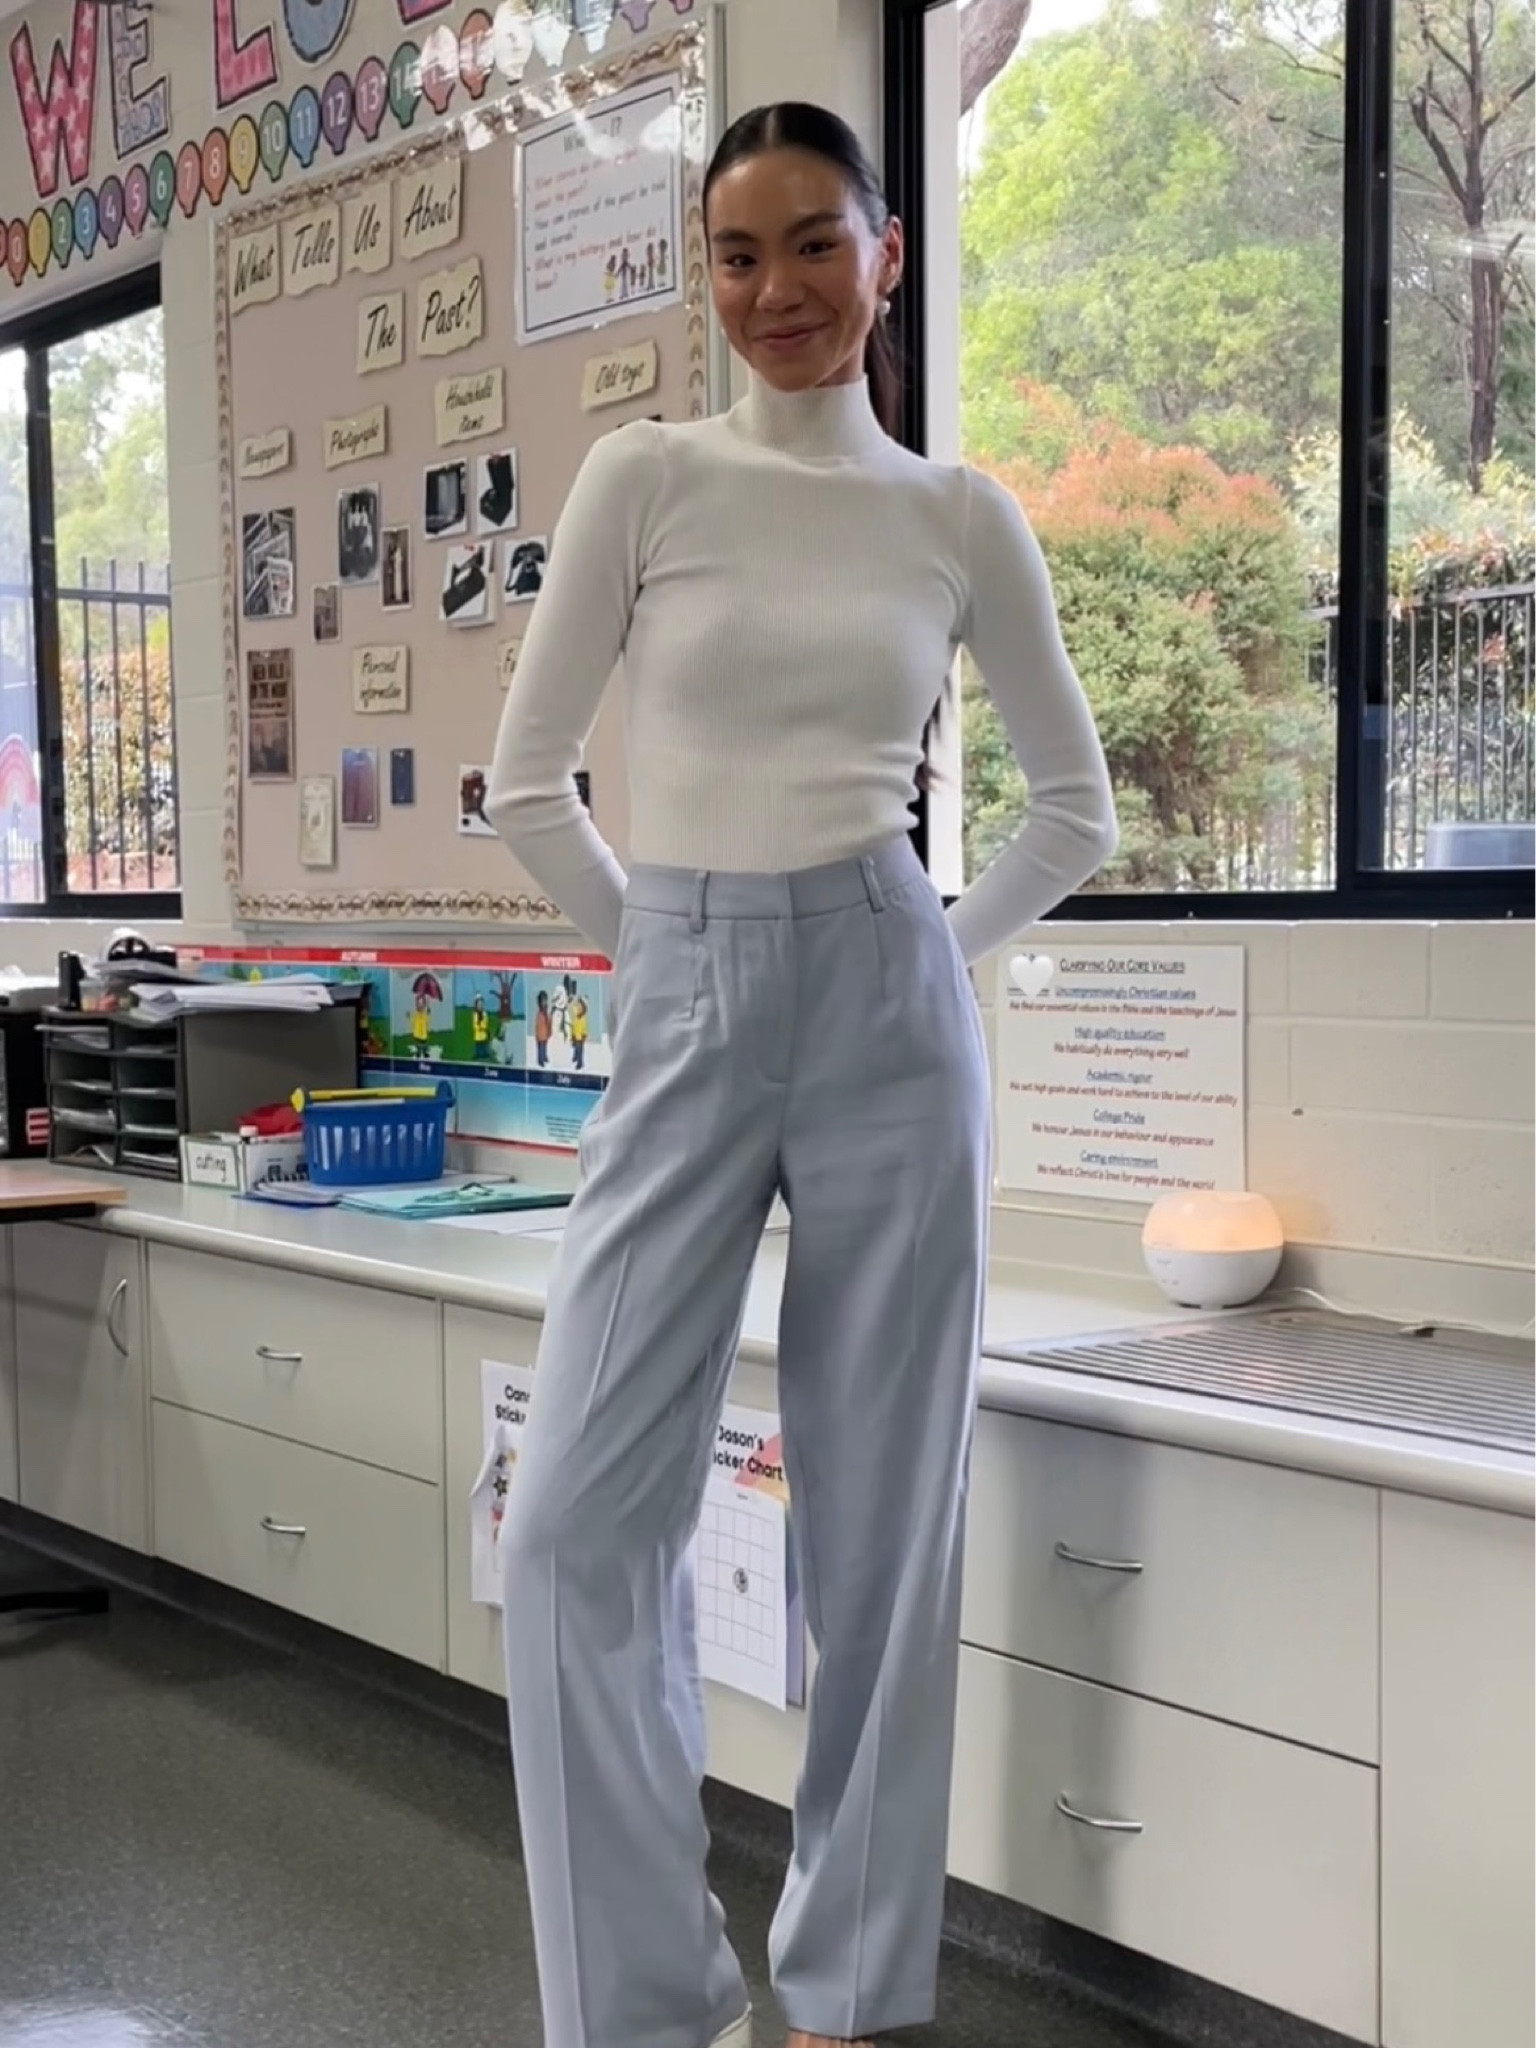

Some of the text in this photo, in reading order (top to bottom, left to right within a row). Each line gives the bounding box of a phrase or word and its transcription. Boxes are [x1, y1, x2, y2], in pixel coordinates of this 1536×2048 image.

[57, 223, 66, 249] 2
[82, 212, 91, 235] 3
[105, 201, 117, 223] 4
[132, 183, 141, 210] 5
[156, 171, 166, 199] 6
[184, 162, 193, 184] 7
[209, 153, 219, 178] 8
[263, 122, 281, 152] 10
[296, 104, 311, 139] 11
[328, 92, 347, 127] 12
[360, 76, 379, 112] 13
[233, 183, 458, 297] What Tells Us About
[365, 274, 481, 358] The Past?
[595, 361, 620, 394] Old
[540, 956, 582, 969] WINTER
[747, 1456, 783, 1482] Chart
